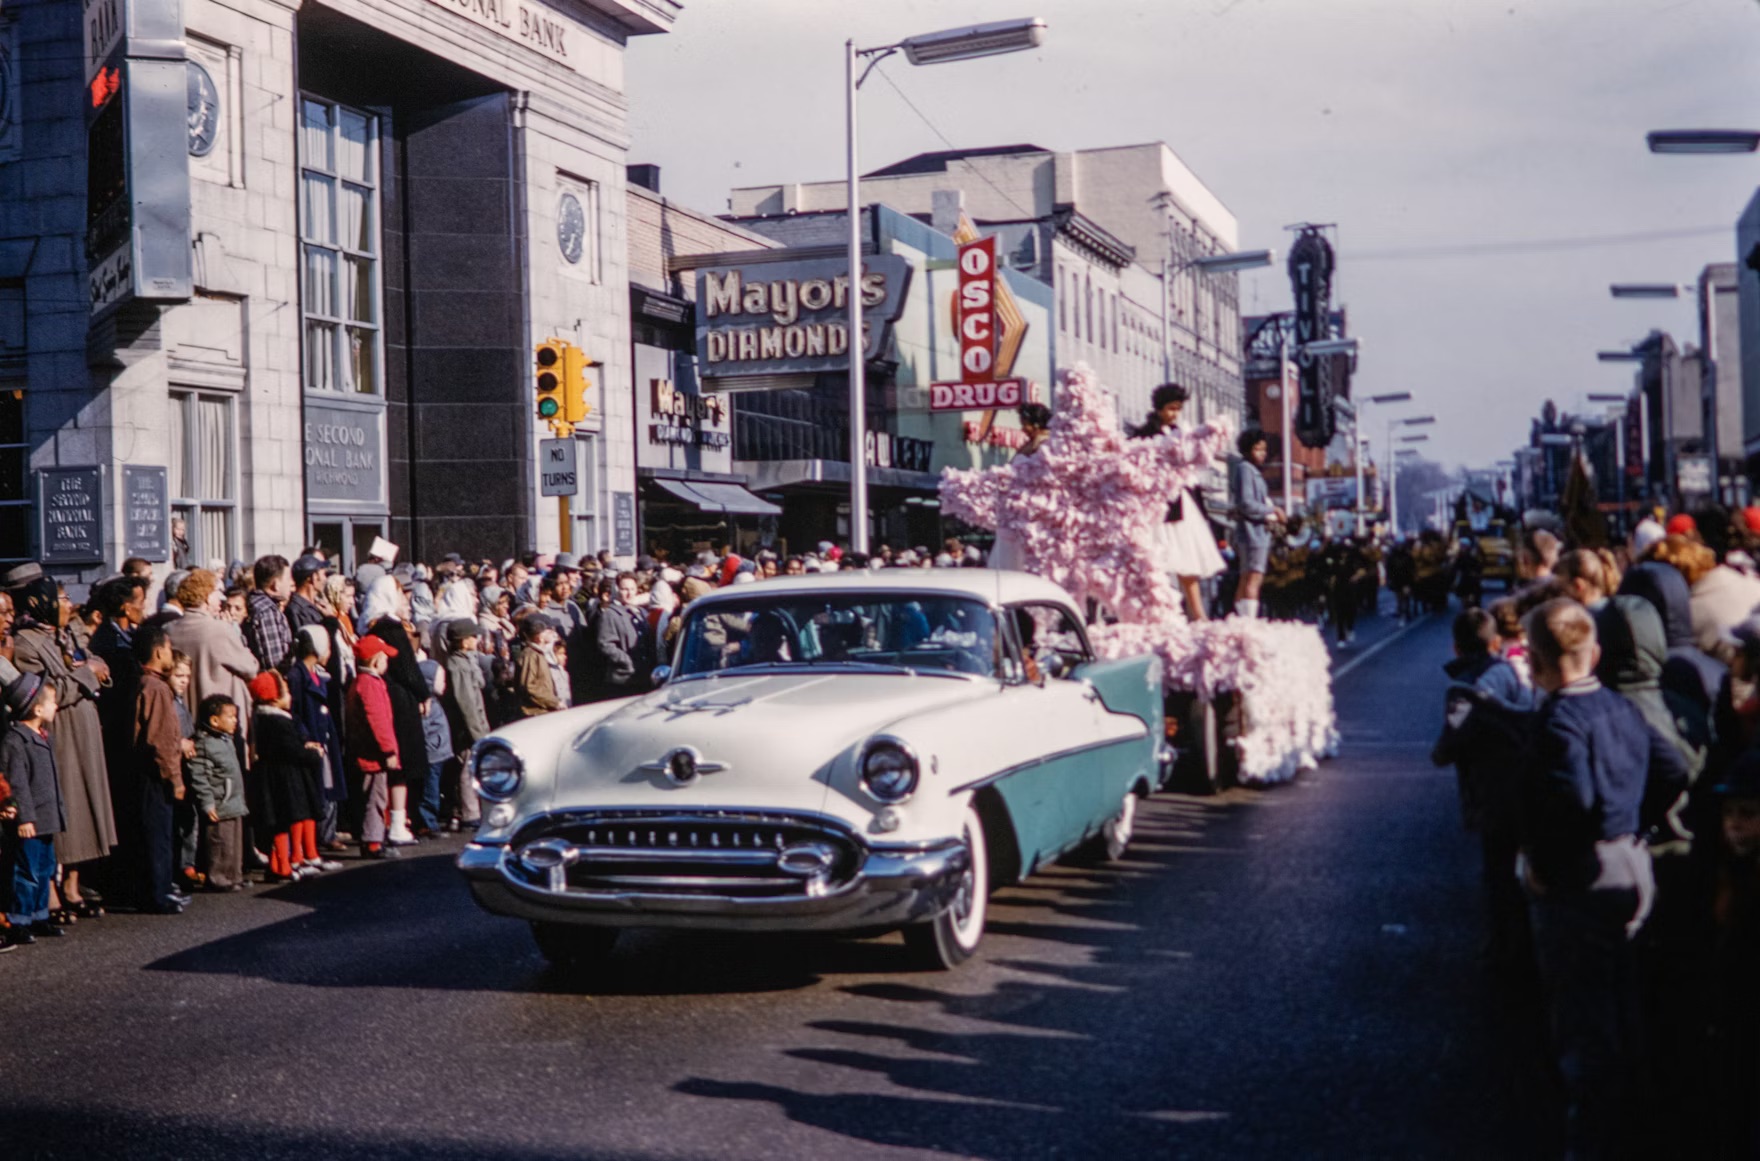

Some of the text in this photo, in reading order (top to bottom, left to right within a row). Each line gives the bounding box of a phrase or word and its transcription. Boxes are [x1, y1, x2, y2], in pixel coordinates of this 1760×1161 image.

[520, 6, 567, 57] BANK
[704, 264, 886, 325] Mayor's
[960, 247, 992, 373] OSCO
[1297, 263, 1314, 424] TIVOLI
[931, 382, 1019, 408] DRUG
[316, 424, 365, 447] SECOND
[345, 450, 374, 471] BANK
[550, 448, 565, 463] NO
[542, 471, 575, 487] TURNS
